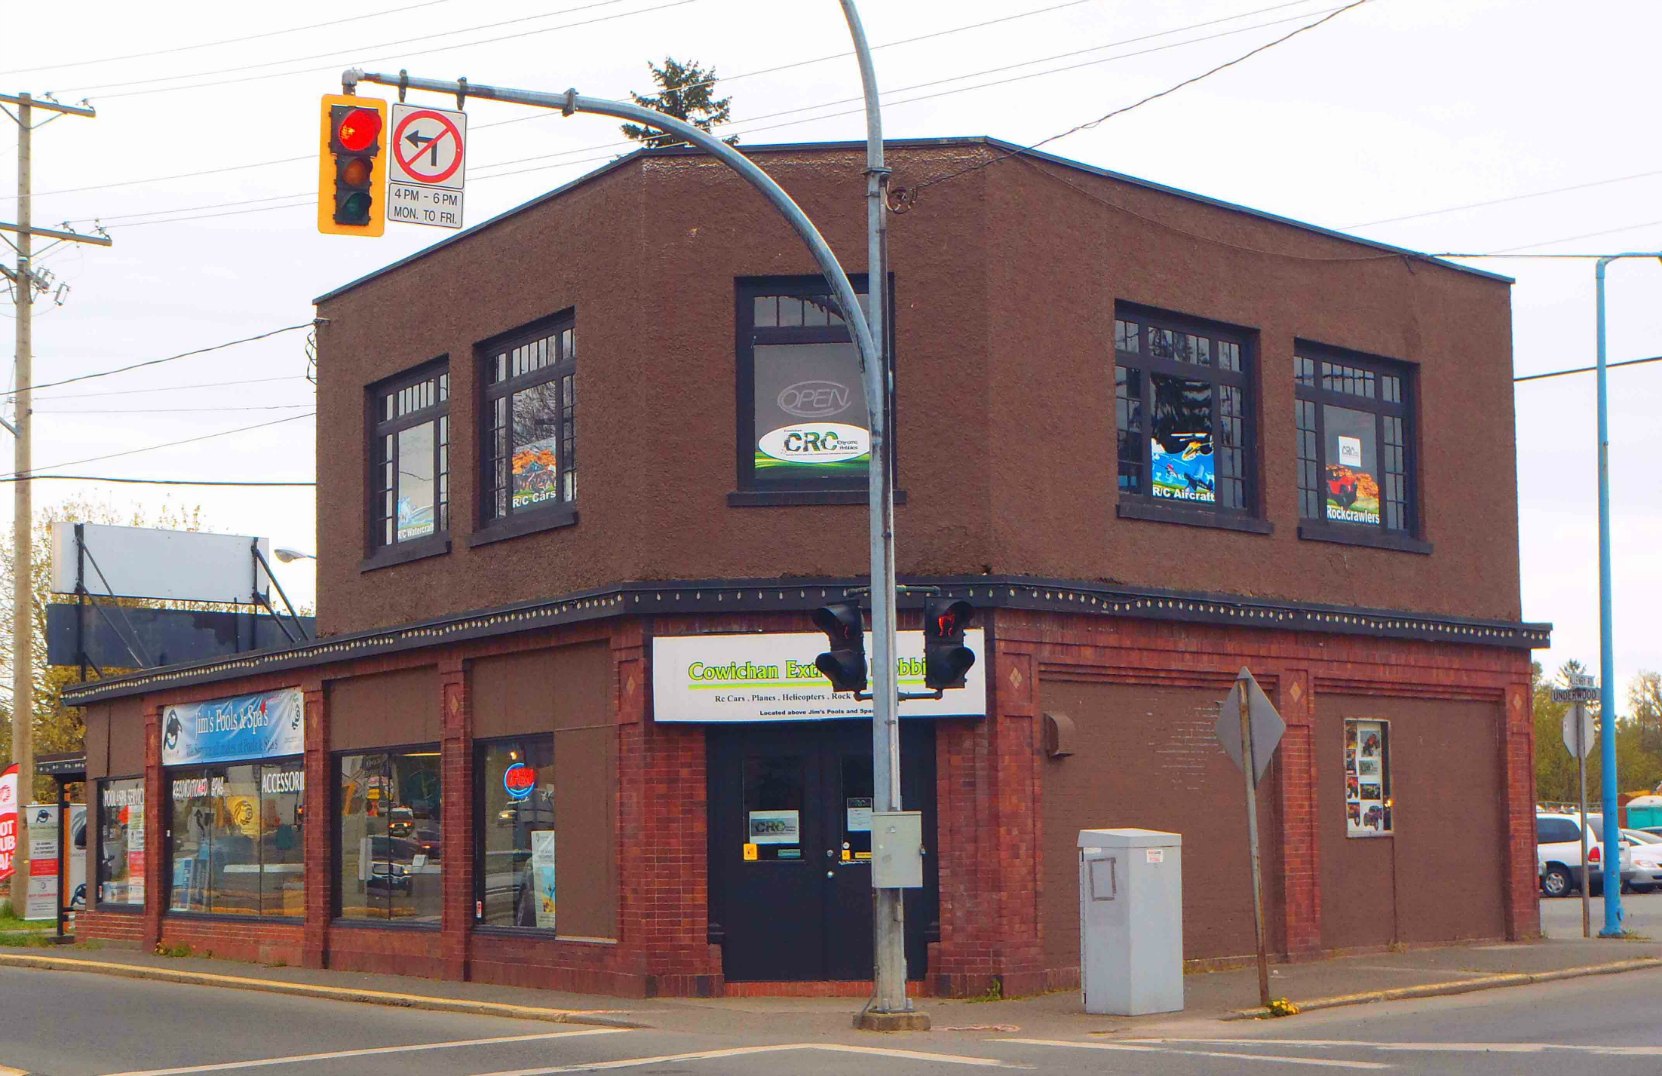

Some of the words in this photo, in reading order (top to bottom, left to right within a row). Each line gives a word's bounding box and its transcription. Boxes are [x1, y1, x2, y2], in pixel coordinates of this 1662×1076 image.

[394, 206, 419, 220] MON.
[423, 209, 436, 221] TO
[440, 211, 457, 224] FRI.
[781, 388, 849, 408] OPEN
[783, 431, 839, 452] CRC
[512, 495, 529, 508] R/C
[532, 490, 556, 503] Cars
[1152, 486, 1171, 498] R/C
[1173, 488, 1215, 502] Aircraft
[1326, 504, 1380, 524] Rockcrawlers
[688, 660, 779, 681] Cowichan
[727, 694, 745, 702] Cars
[751, 694, 776, 702] Planes
[782, 693, 825, 702] Helicopters
[831, 692, 851, 700] Rock
[1553, 689, 1597, 700] UNDERWOOD
[195, 710, 214, 738] Jim's
[215, 706, 238, 732] Pools
[239, 708, 247, 730] &
[0, 820, 14, 836] OT
[755, 820, 785, 832] CRC
[0, 836, 16, 851] UB
